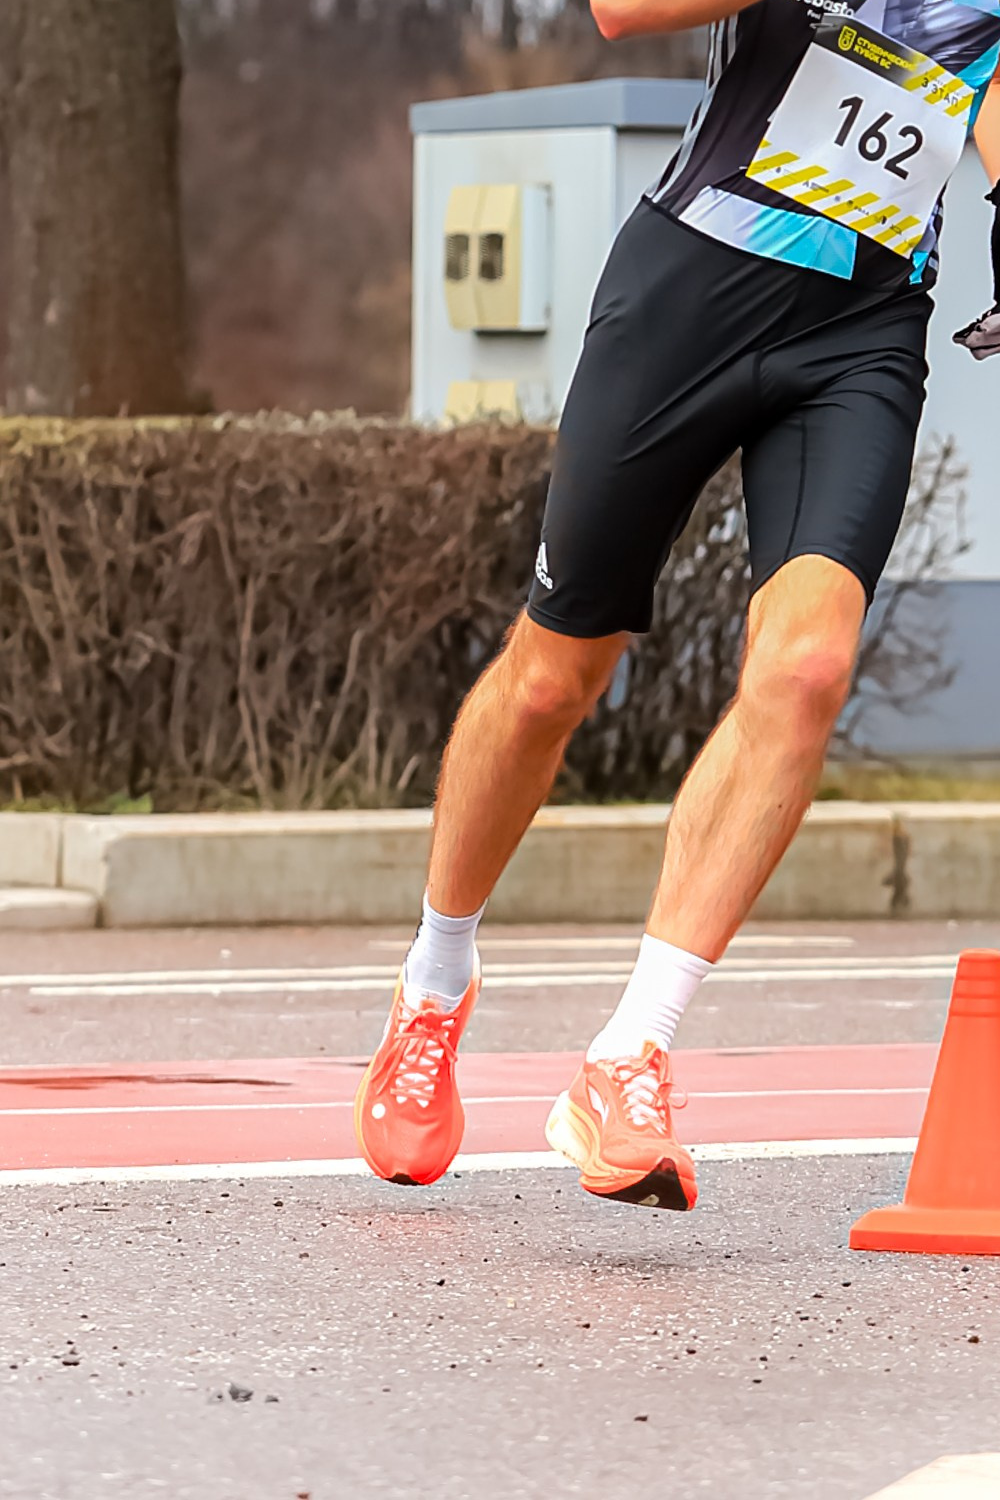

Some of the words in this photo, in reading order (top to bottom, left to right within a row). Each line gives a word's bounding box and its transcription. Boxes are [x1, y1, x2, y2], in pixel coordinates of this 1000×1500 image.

[857, 36, 917, 72] СТУДЕНЧЕСКИ
[921, 77, 930, 88] 3
[931, 83, 959, 108] ЭТАП
[834, 96, 923, 180] 162
